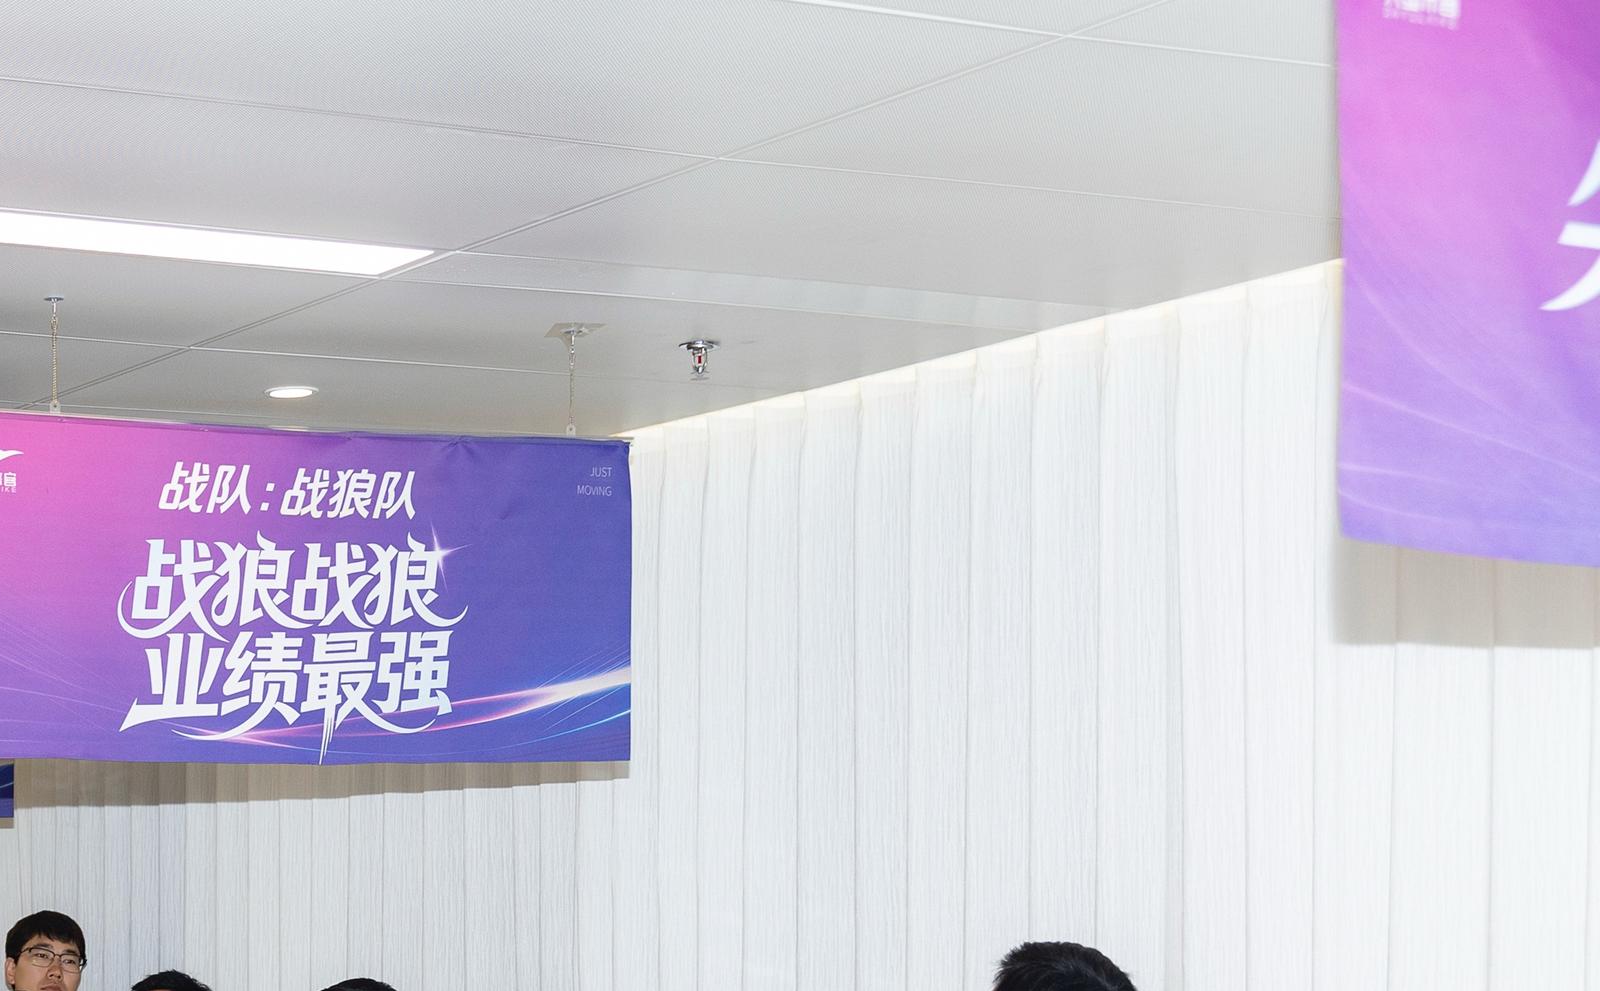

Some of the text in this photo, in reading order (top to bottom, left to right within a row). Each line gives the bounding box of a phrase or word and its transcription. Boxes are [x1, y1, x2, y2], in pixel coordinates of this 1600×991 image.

[158, 461, 416, 520] 战队：战狼队
[577, 484, 612, 497] MOVING
[590, 466, 613, 478] JUST
[117, 530, 469, 643] 战狼战狼
[118, 630, 455, 766] 业绩最强
